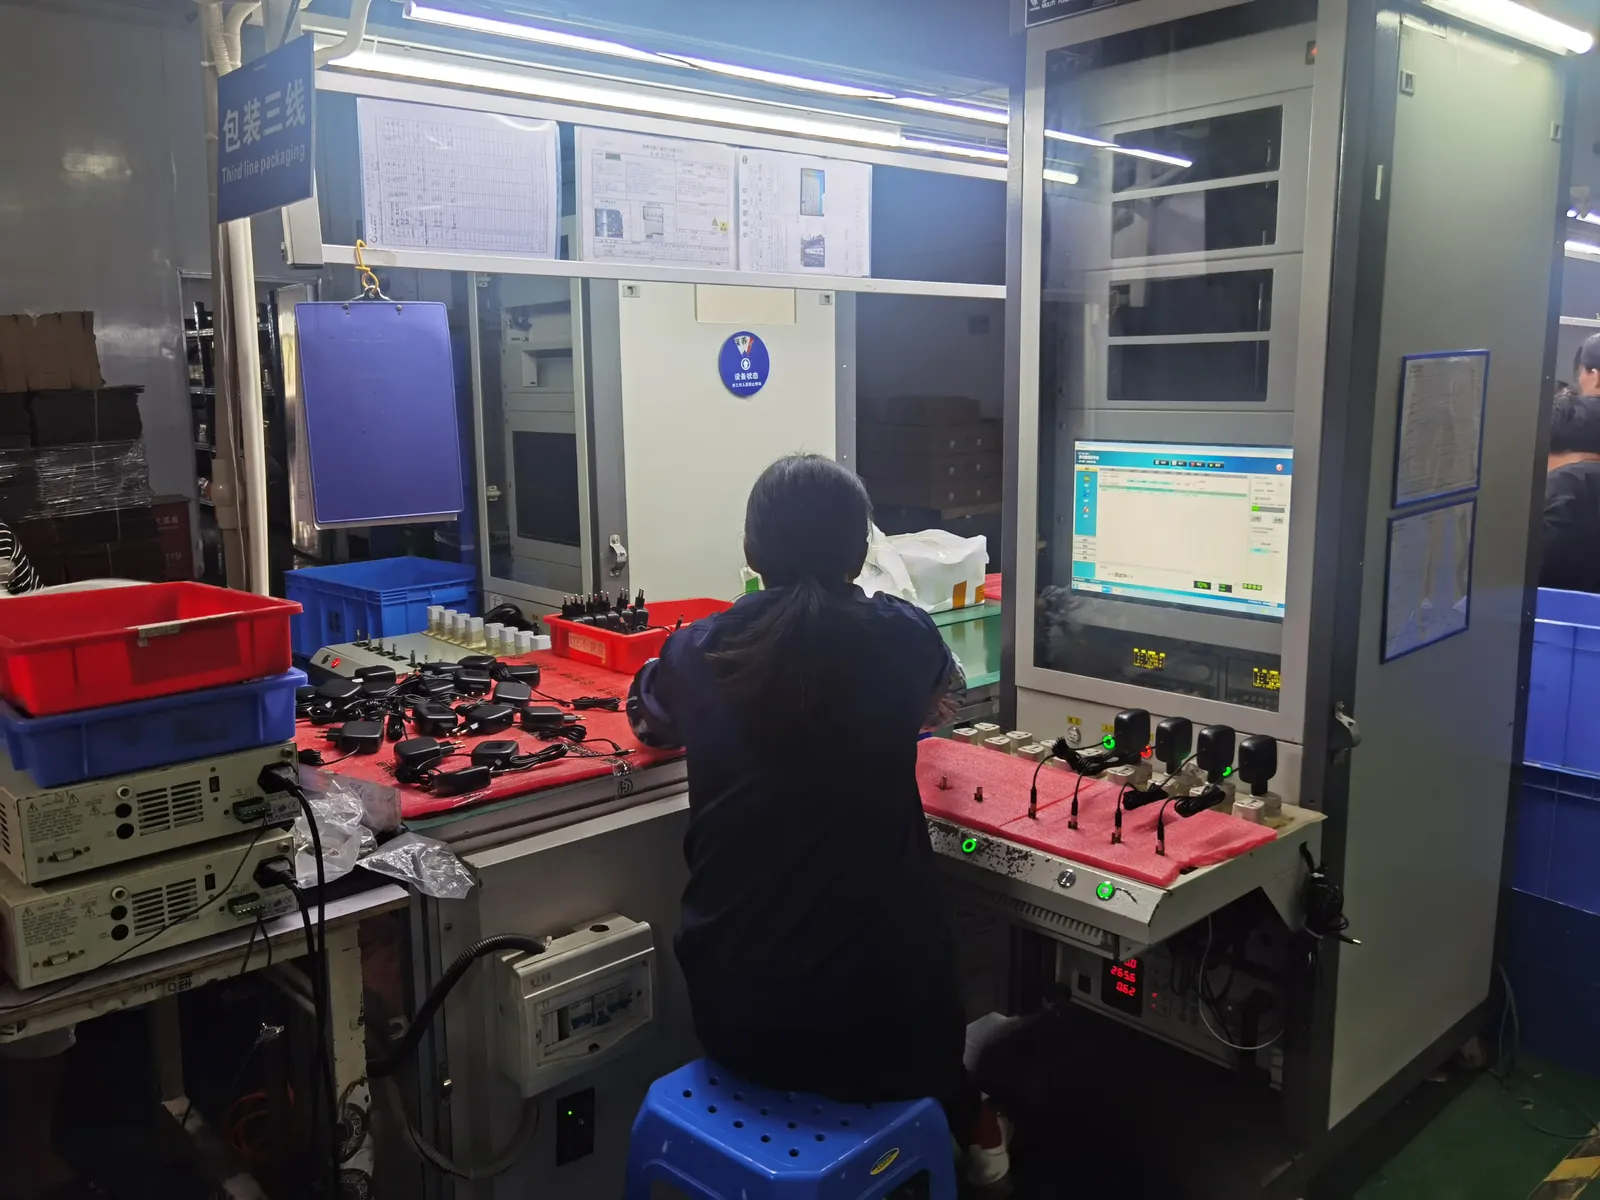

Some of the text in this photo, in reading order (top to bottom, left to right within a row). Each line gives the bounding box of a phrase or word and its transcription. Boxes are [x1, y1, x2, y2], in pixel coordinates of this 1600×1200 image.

[223, 78, 305, 153] 包装三线
[222, 143, 305, 184] Third line packaging
